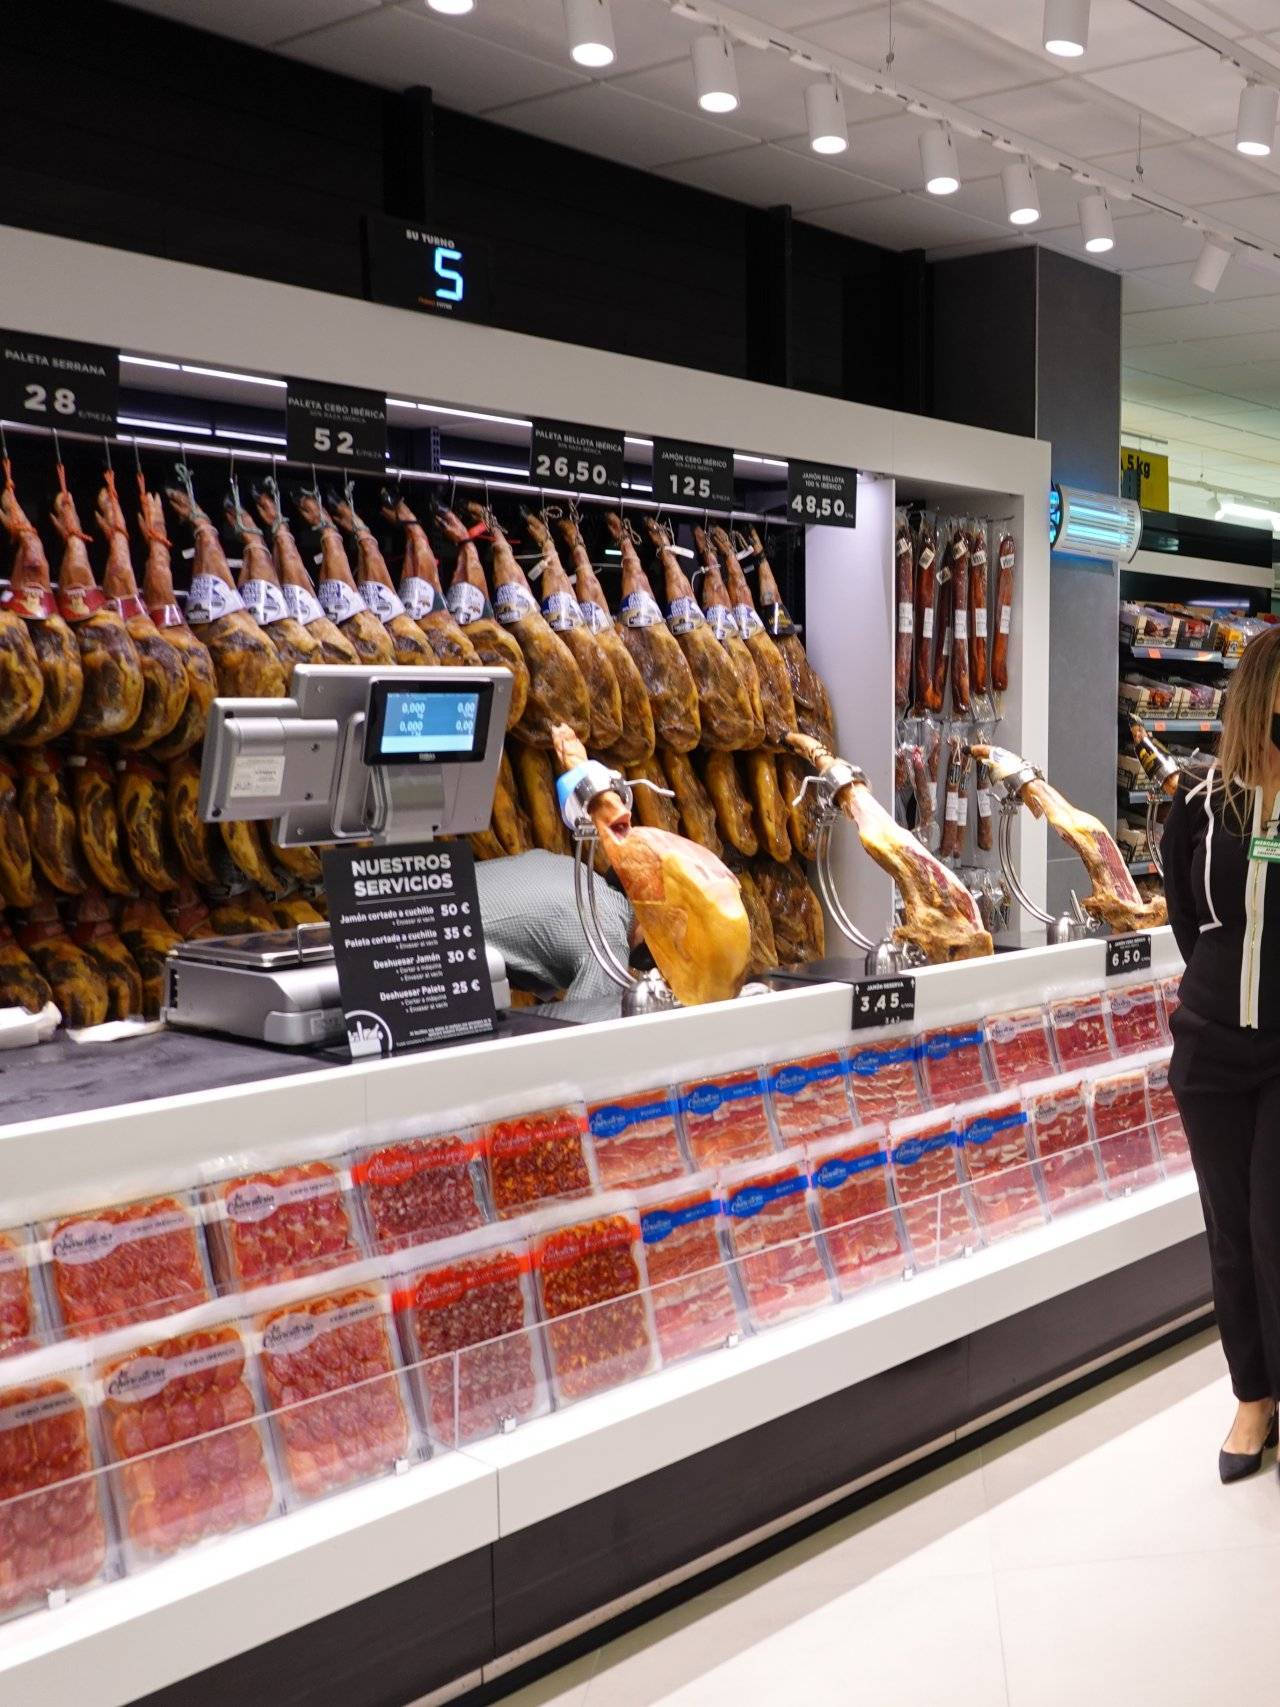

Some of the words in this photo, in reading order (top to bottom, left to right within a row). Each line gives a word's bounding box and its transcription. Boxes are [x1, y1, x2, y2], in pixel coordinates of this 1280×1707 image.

[435, 246, 463, 301] 5
[5, 349, 49, 366] PALETA
[52, 357, 106, 376] SERRANA
[24, 384, 76, 415] 28
[288, 397, 322, 410] PALETA
[324, 402, 349, 414] CEBO
[313, 427, 354, 455] 52
[535, 429, 562, 441] PALETA
[563, 435, 594, 446] BELLOTA
[662, 452, 684, 461] JAMÓN
[536, 454, 607, 485] 26,50
[802, 472, 822, 480] JAMÓN
[822, 474, 845, 484] BELLOTA
[669, 474, 711, 498] 125
[791, 494, 845, 519] 48,50
[351, 853, 451, 877] NUESTROS
[354, 873, 453, 898] SERVICIOS
[339, 911, 367, 925] Jamón
[367, 909, 397, 921] cortado
[404, 906, 434, 917] cuchillo
[440, 904, 458, 917] 50
[461, 902, 470, 914] €
[344, 938, 370, 949] Paleta
[371, 933, 400, 945] cortada
[408, 930, 437, 941] cuchillo
[443, 926, 460, 941] 35
[462, 924, 473, 938] €
[373, 956, 414, 970] Deshuesar
[416, 952, 441, 964] Jamón
[447, 950, 465, 964] 30
[467, 948, 478, 961] €
[1112, 950, 1141, 967] 6,50
[379, 987, 420, 1002] Deshuesar
[421, 984, 446, 995] Paleta
[451, 980, 468, 995] 25
[470, 978, 481, 992] €
[866, 983, 884, 991] JAMÓN
[860, 992, 900, 1013] 3,45
